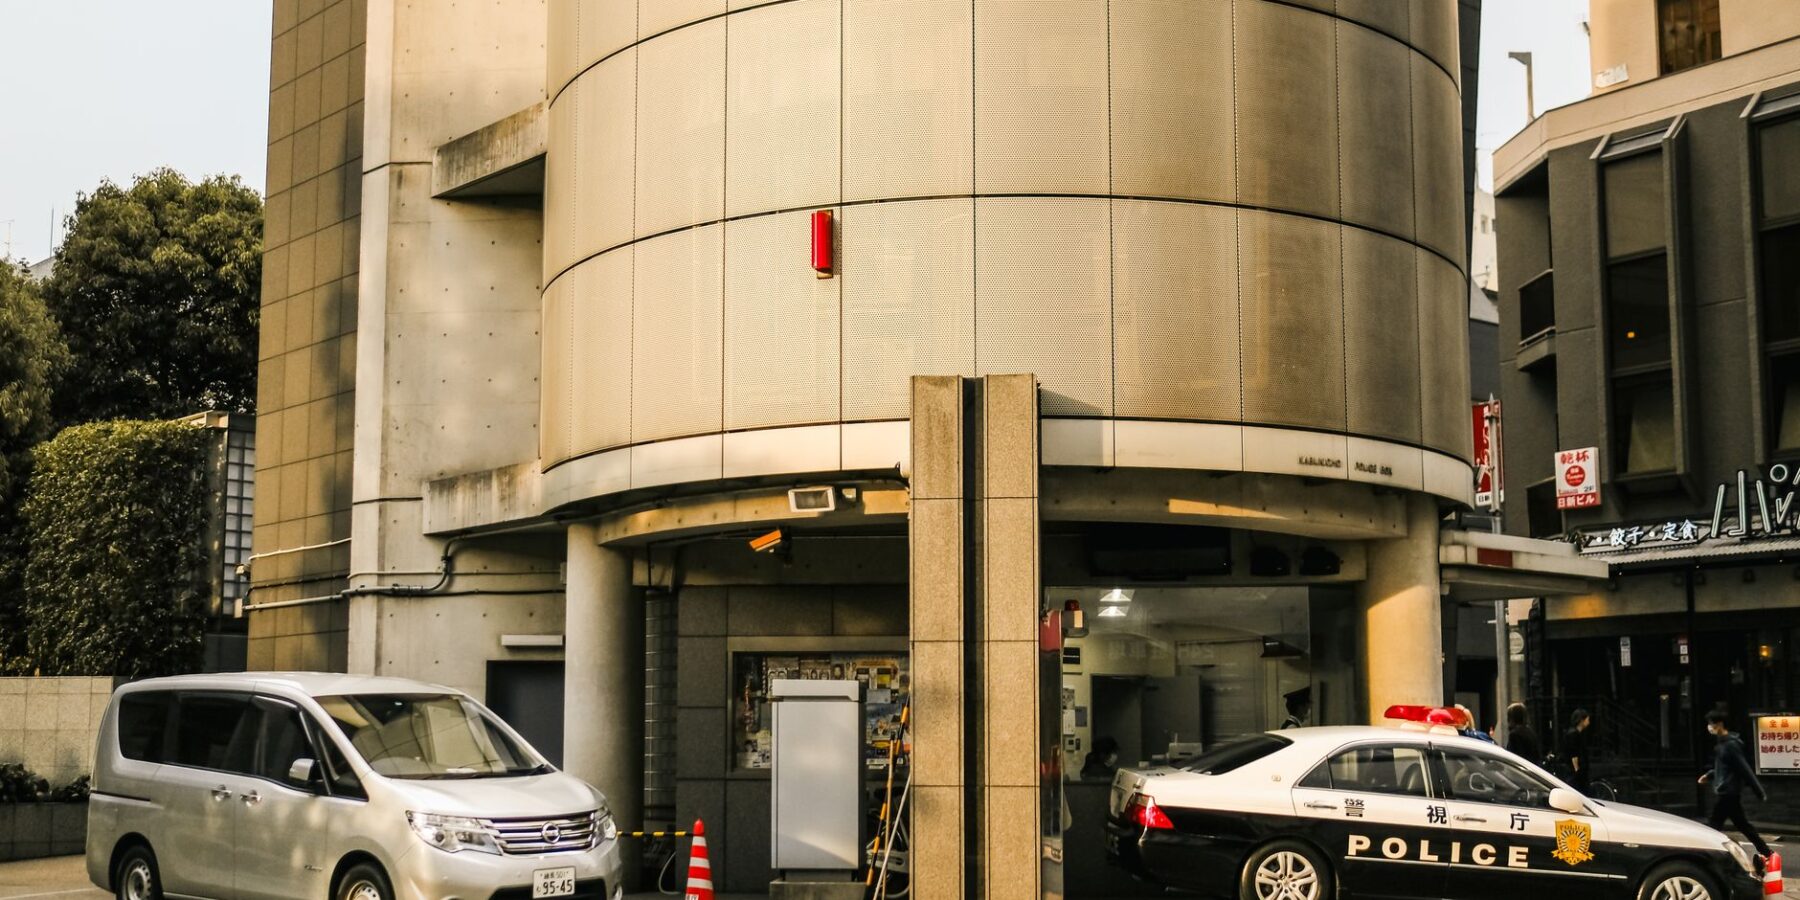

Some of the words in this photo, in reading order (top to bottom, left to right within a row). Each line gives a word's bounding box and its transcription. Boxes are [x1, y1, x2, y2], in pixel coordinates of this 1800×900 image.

[1354, 462, 1377, 474] POLICE
[1761, 732, 1799, 740] お持ち帰り
[1761, 745, 1800, 753] 始めました
[1347, 834, 1529, 868] POLICE
[542, 879, 573, 896] 95-45
